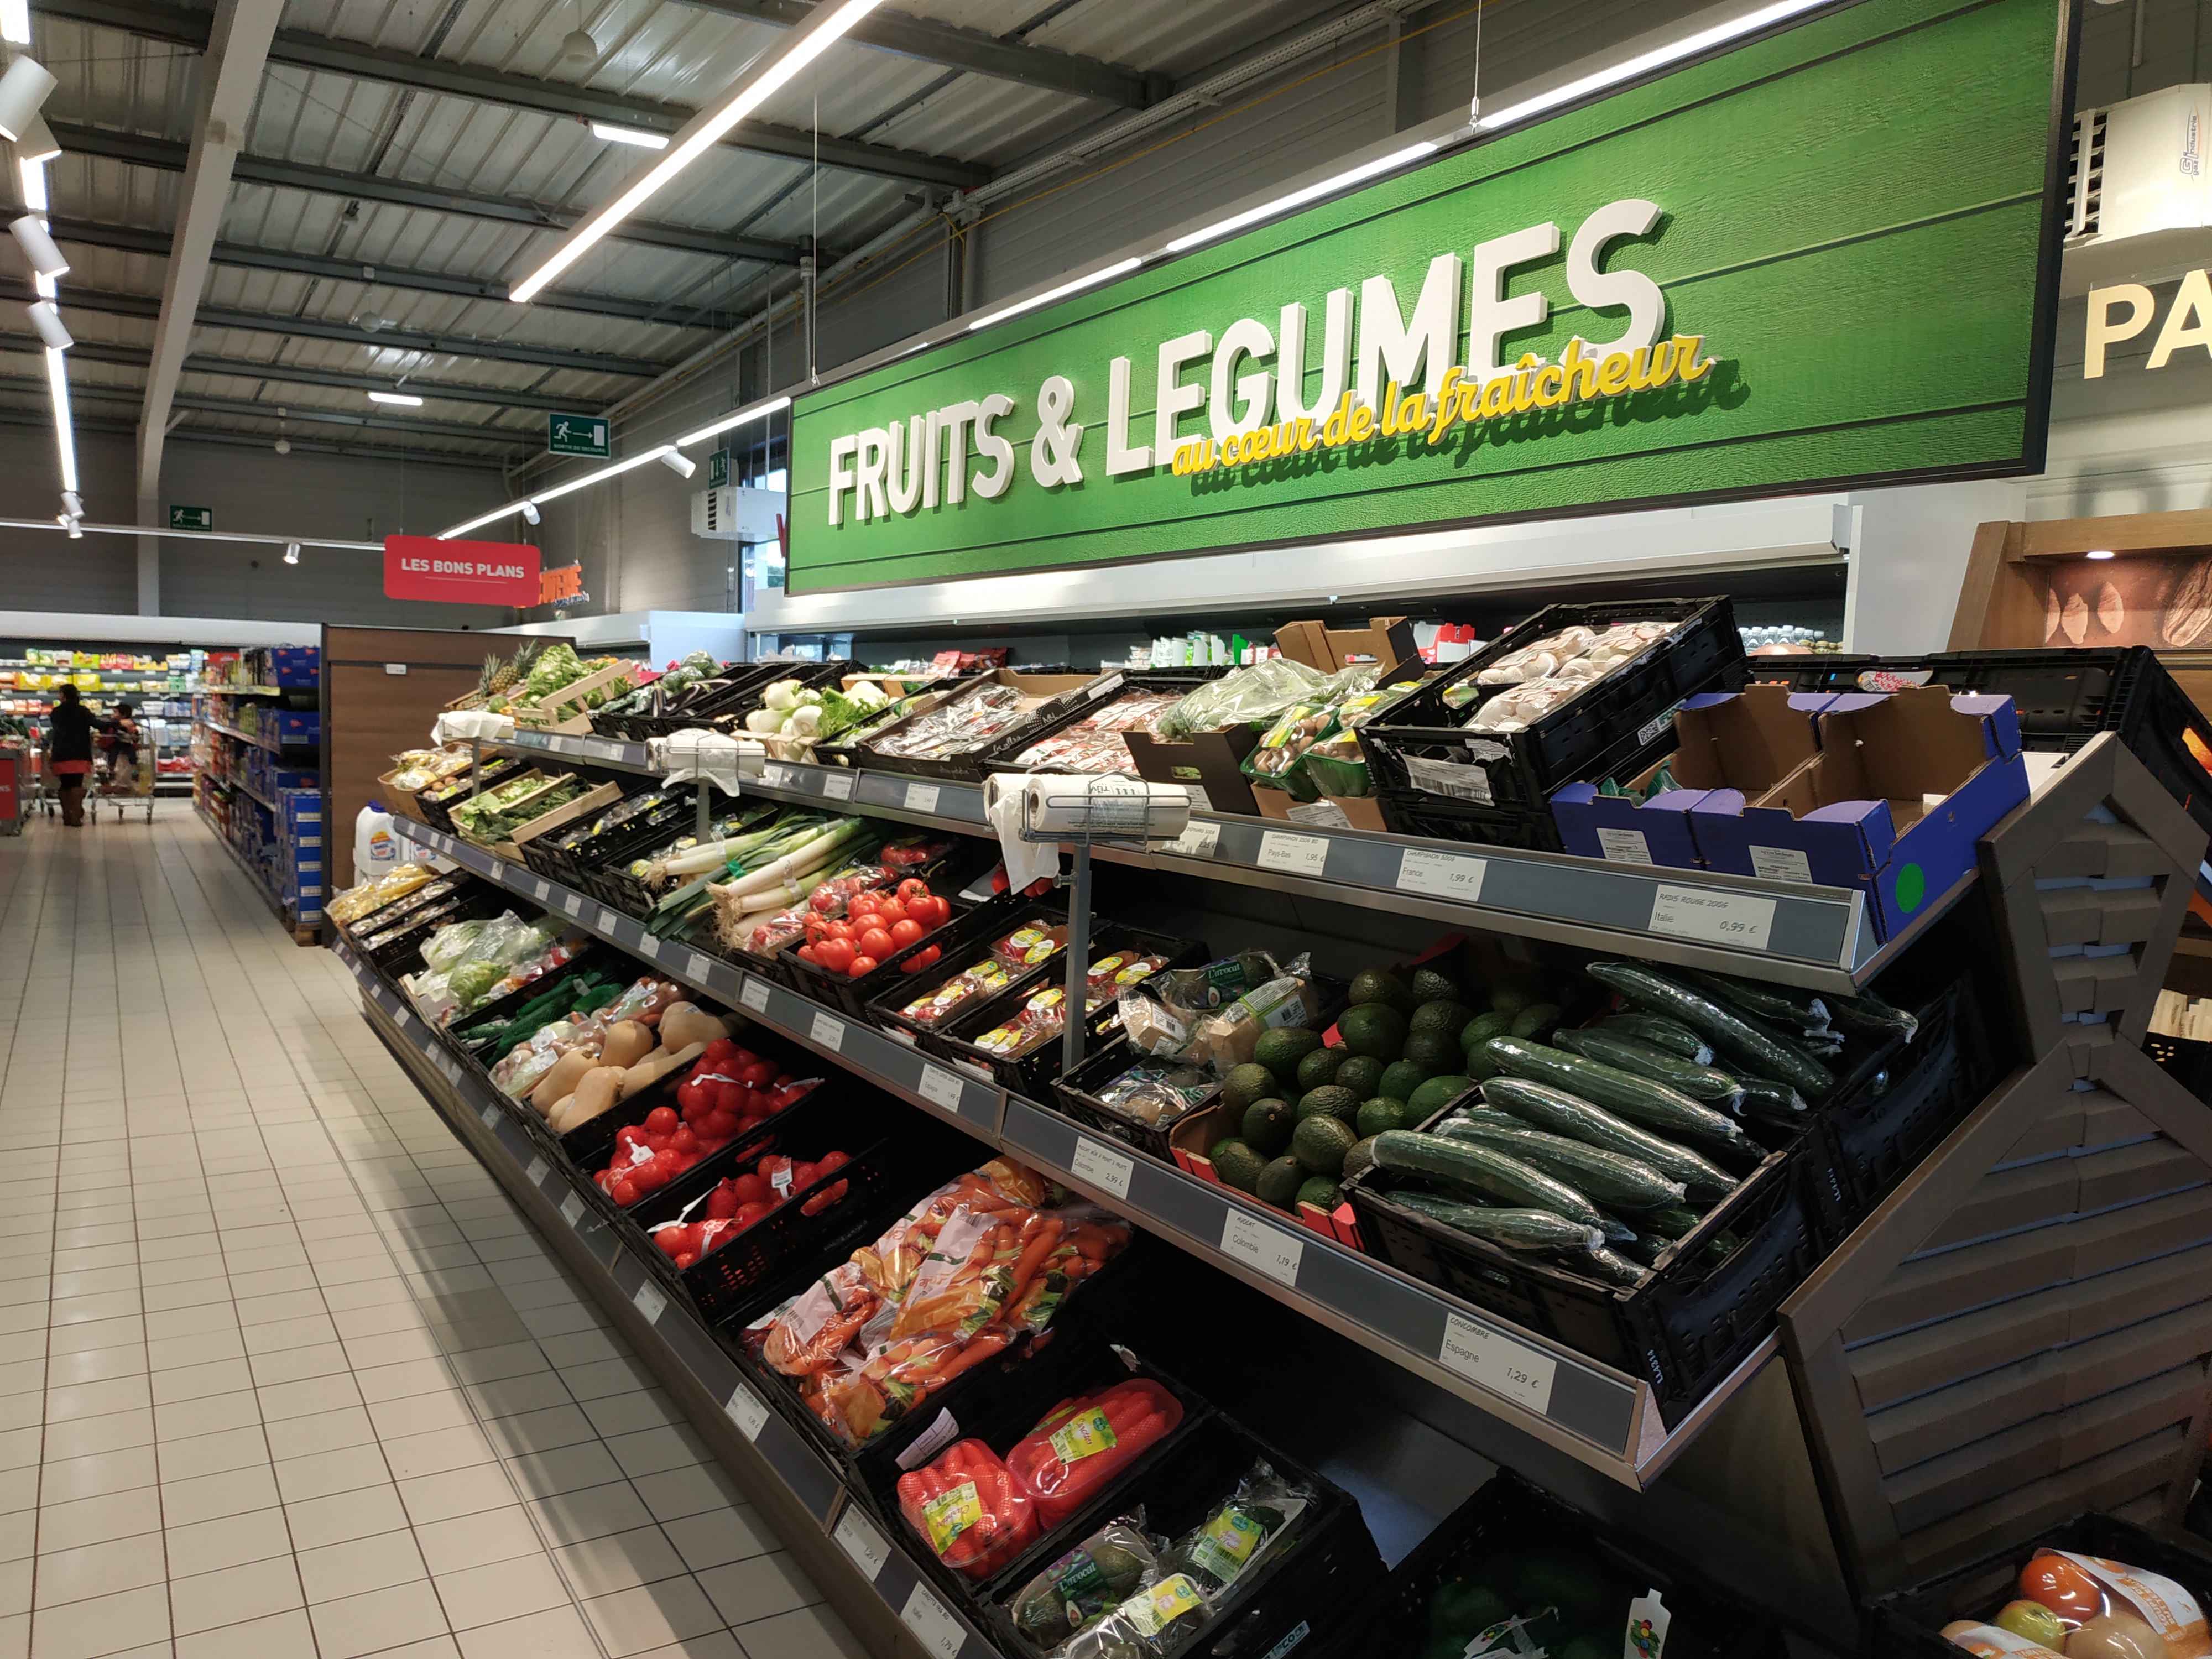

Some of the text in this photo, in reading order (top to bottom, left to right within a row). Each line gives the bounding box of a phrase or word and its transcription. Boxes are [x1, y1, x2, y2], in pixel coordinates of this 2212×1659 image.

[2084, 268, 2212, 379] PA
[828, 199, 1663, 526] FRUITS & LEGUMES
[1172, 335, 1719, 477] au cœur de la fraîcheur
[401, 557, 525, 579] LES BONS PLANS
[1271, 833, 1299, 842] CHAMPIGNON
[1267, 848, 1291, 859] Pays-Bas
[1305, 853, 1318, 862] 1,95
[1406, 849, 1439, 860] CHAMPIGNON
[1402, 867, 1424, 878] France
[1449, 873, 1466, 883] 1,99
[1658, 893, 1729, 909] RADIS ROUGE 200G
[1653, 911, 1674, 923] Italie
[1719, 920, 1759, 934] 0,99 €
[1208, 963, 1241, 979] L'avocat
[1074, 1158, 1094, 1173] Colombie
[1115, 1162, 1128, 1171] FRUITS
[1105, 1172, 1118, 1184] 2,99
[1237, 1216, 1256, 1228] AVOCAT
[1232, 1234, 1259, 1254] Colombie
[1276, 1254, 1290, 1266] 1,19
[1449, 1317, 1490, 1340] CONCOMBRE
[1445, 1338, 1480, 1363] Espagne
[1647, 1349, 1663, 1384] LL4314
[1506, 1366, 1539, 1389] 1,29 €
[1058, 1562, 1097, 1592] L'avocat
[941, 1636, 953, 1651] 1,79
